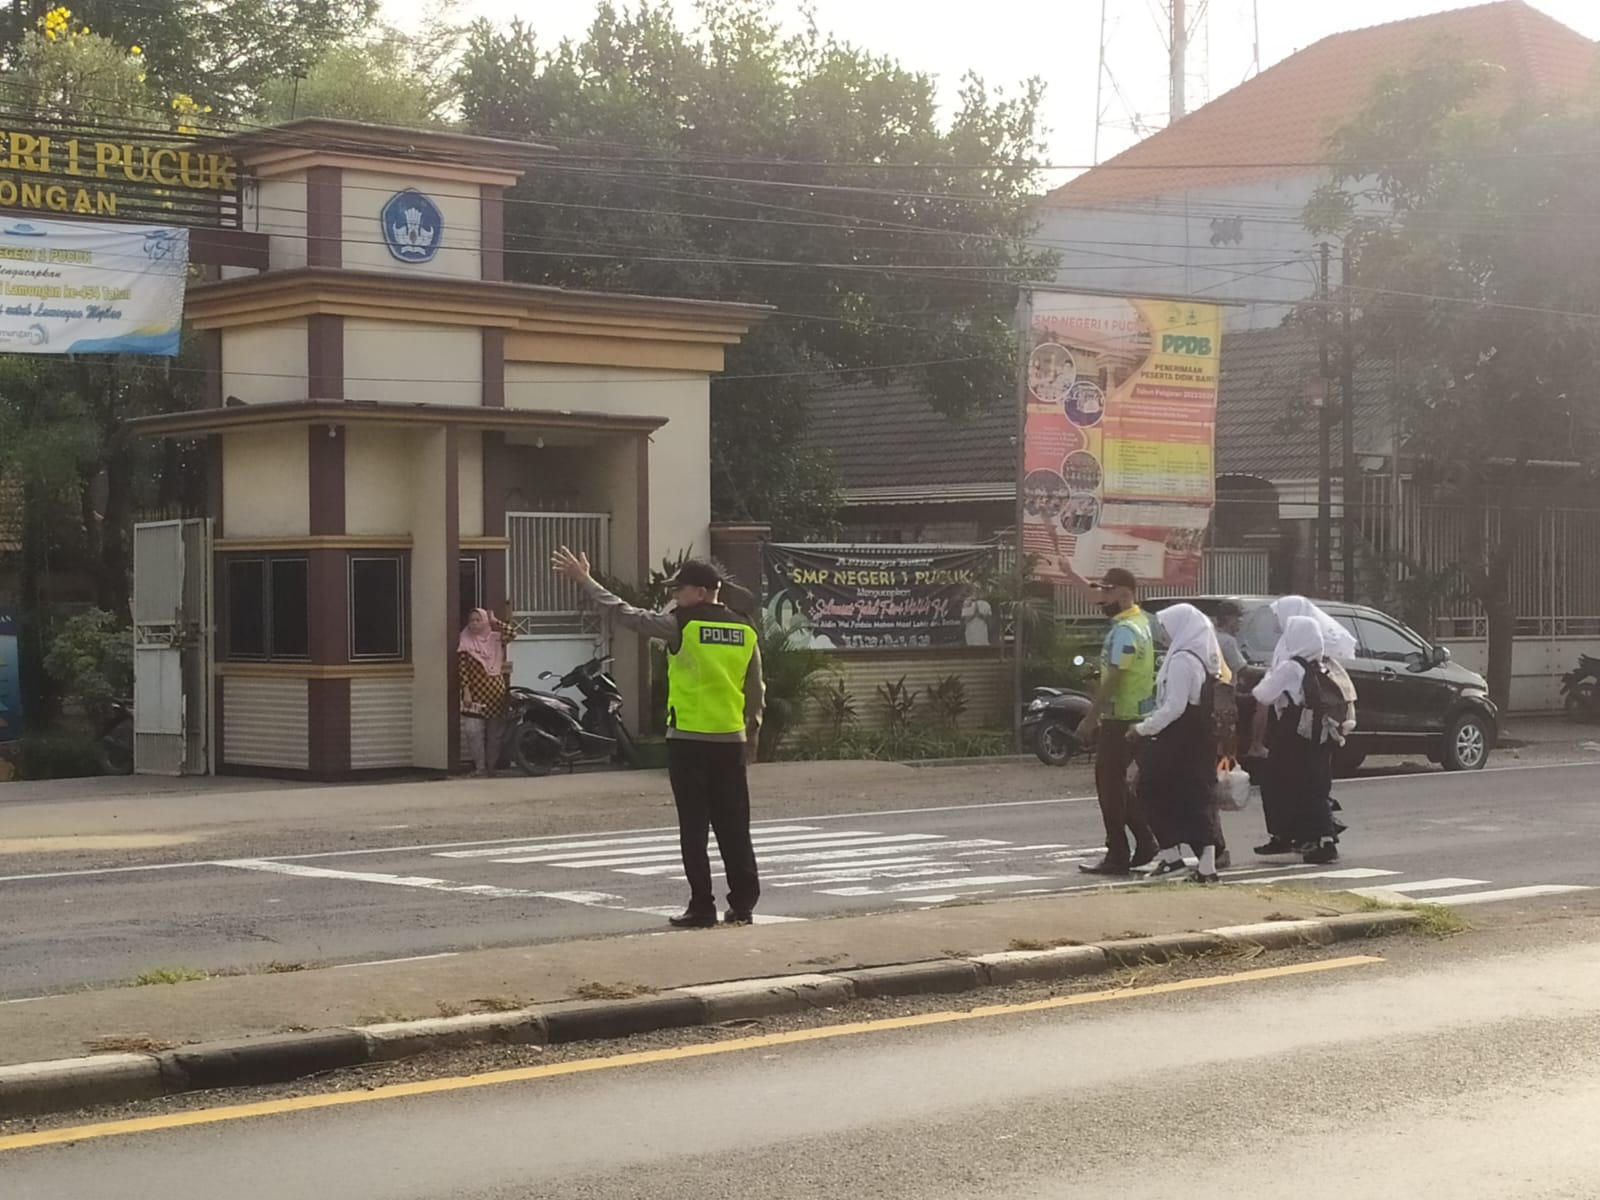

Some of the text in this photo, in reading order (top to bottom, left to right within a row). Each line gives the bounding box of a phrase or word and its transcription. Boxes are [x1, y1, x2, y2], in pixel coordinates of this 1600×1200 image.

[64, 139, 82, 175] 1
[95, 142, 238, 191] PUCUK
[0, 180, 117, 215] ONGAN
[1061, 316, 1101, 330] NEGERI
[1162, 334, 1212, 356] PPDB
[793, 568, 828, 585] SMP
[834, 570, 896, 586] NEGERI
[702, 628, 743, 643] POLISI
